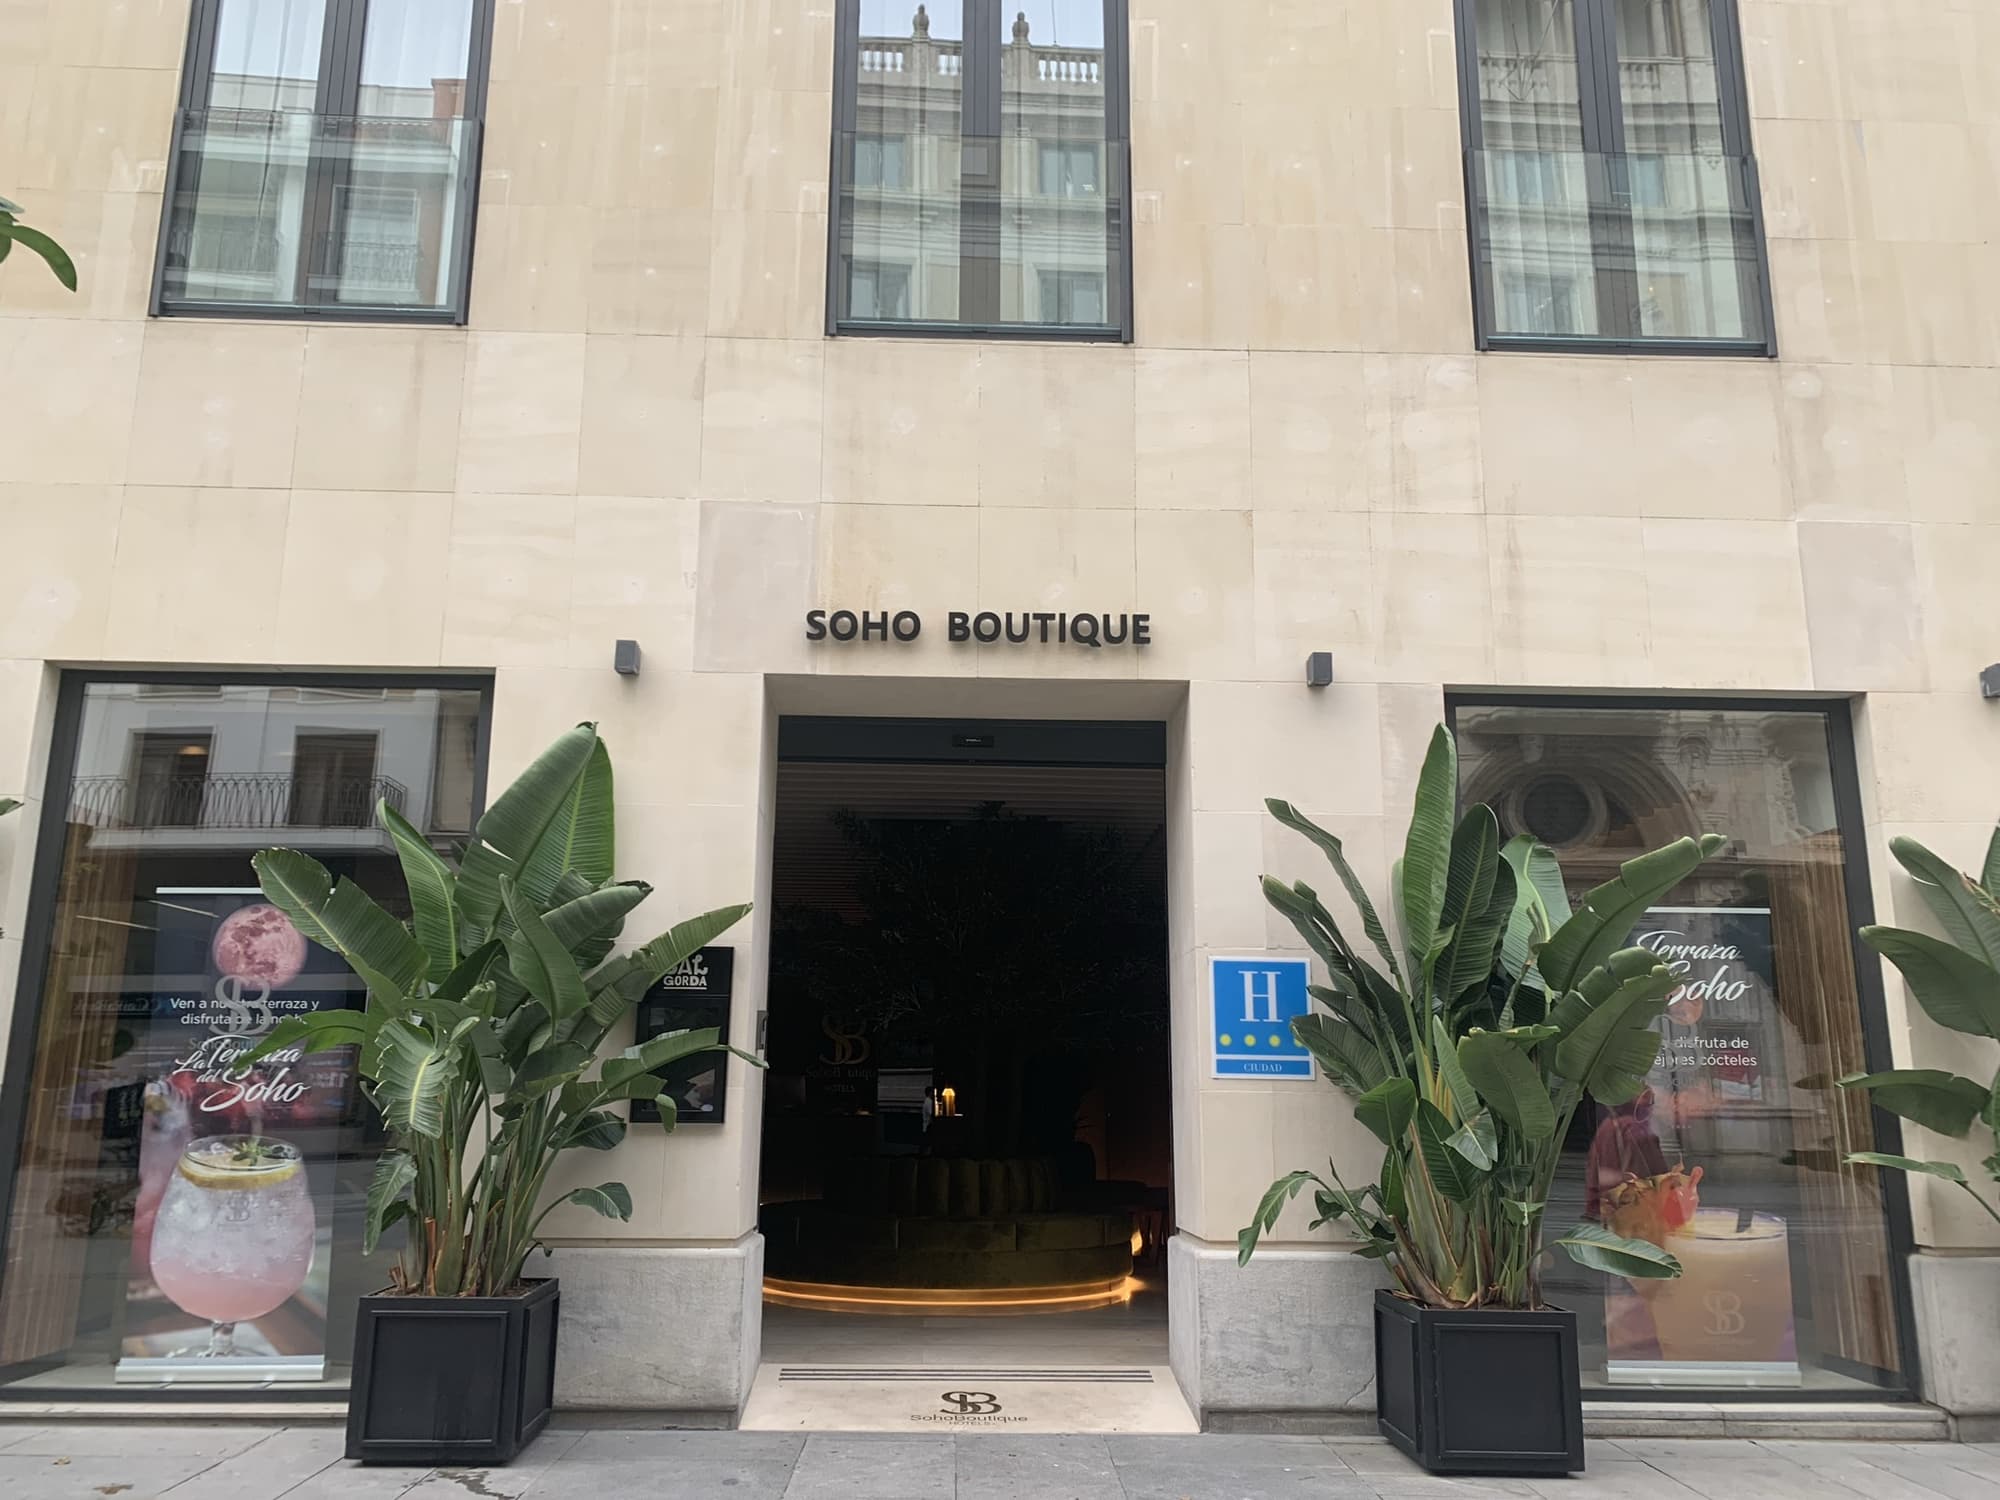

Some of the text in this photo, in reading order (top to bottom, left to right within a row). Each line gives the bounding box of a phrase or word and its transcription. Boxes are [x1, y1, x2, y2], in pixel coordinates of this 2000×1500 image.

[806, 610, 1151, 647] SOHO BOUTIQUE
[1636, 930, 1741, 961] Terraza
[667, 954, 709, 975] AL
[663, 976, 708, 986] GORDA
[1237, 970, 1283, 1022] H
[170, 998, 195, 1009] Ven
[199, 1001, 207, 1009] a
[311, 1000, 319, 1011] y
[181, 1013, 231, 1025] disfruta
[1731, 1037, 1749, 1048] de
[1243, 1063, 1282, 1072] CIUDAD
[200, 1063, 311, 1112] Soho
[911, 1414, 1028, 1424] SohoBoutique
